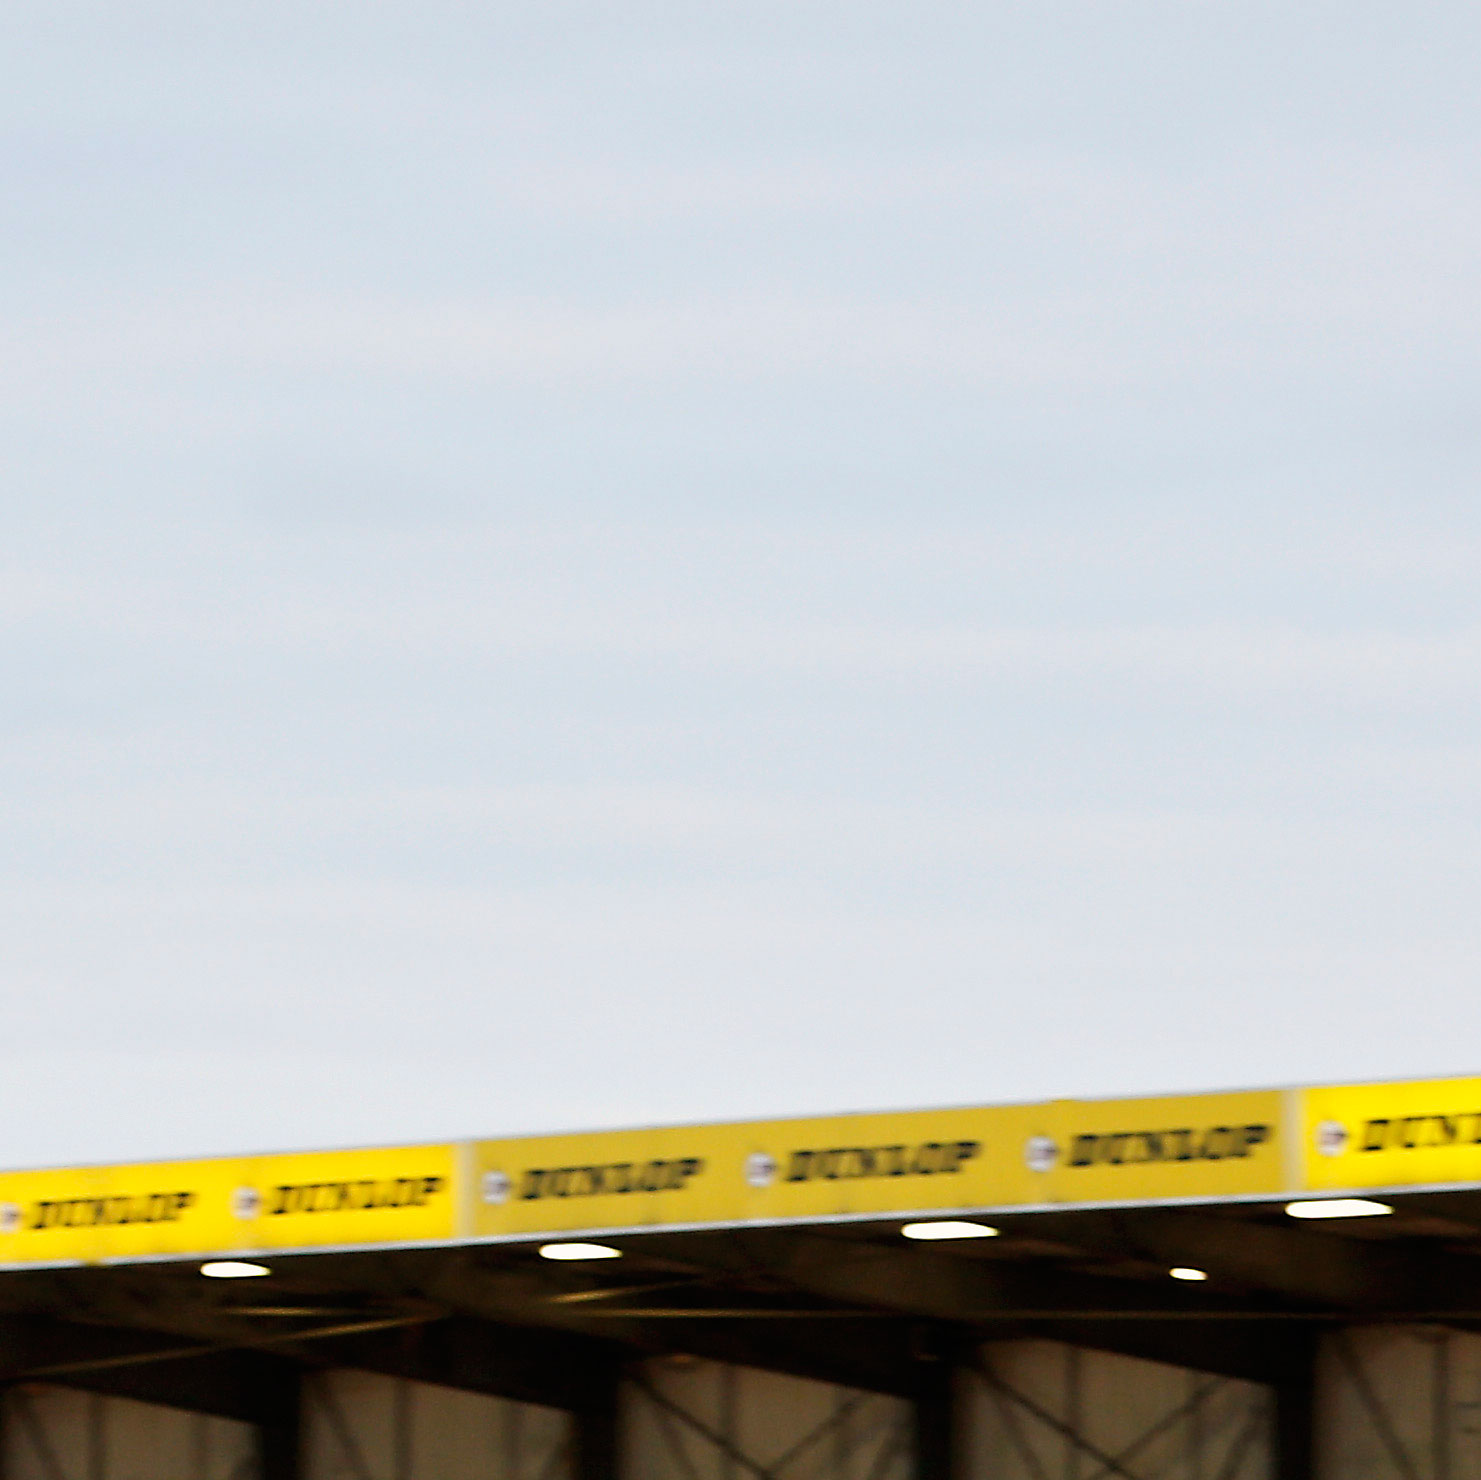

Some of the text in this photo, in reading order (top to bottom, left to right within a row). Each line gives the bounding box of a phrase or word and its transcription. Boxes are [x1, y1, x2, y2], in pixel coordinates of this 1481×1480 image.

[519, 1123, 1271, 1202] DUNLOP DUNLOP DUNLOP
[29, 1191, 195, 1230] DUNLOP
[268, 1176, 444, 1216] DUNLOP
